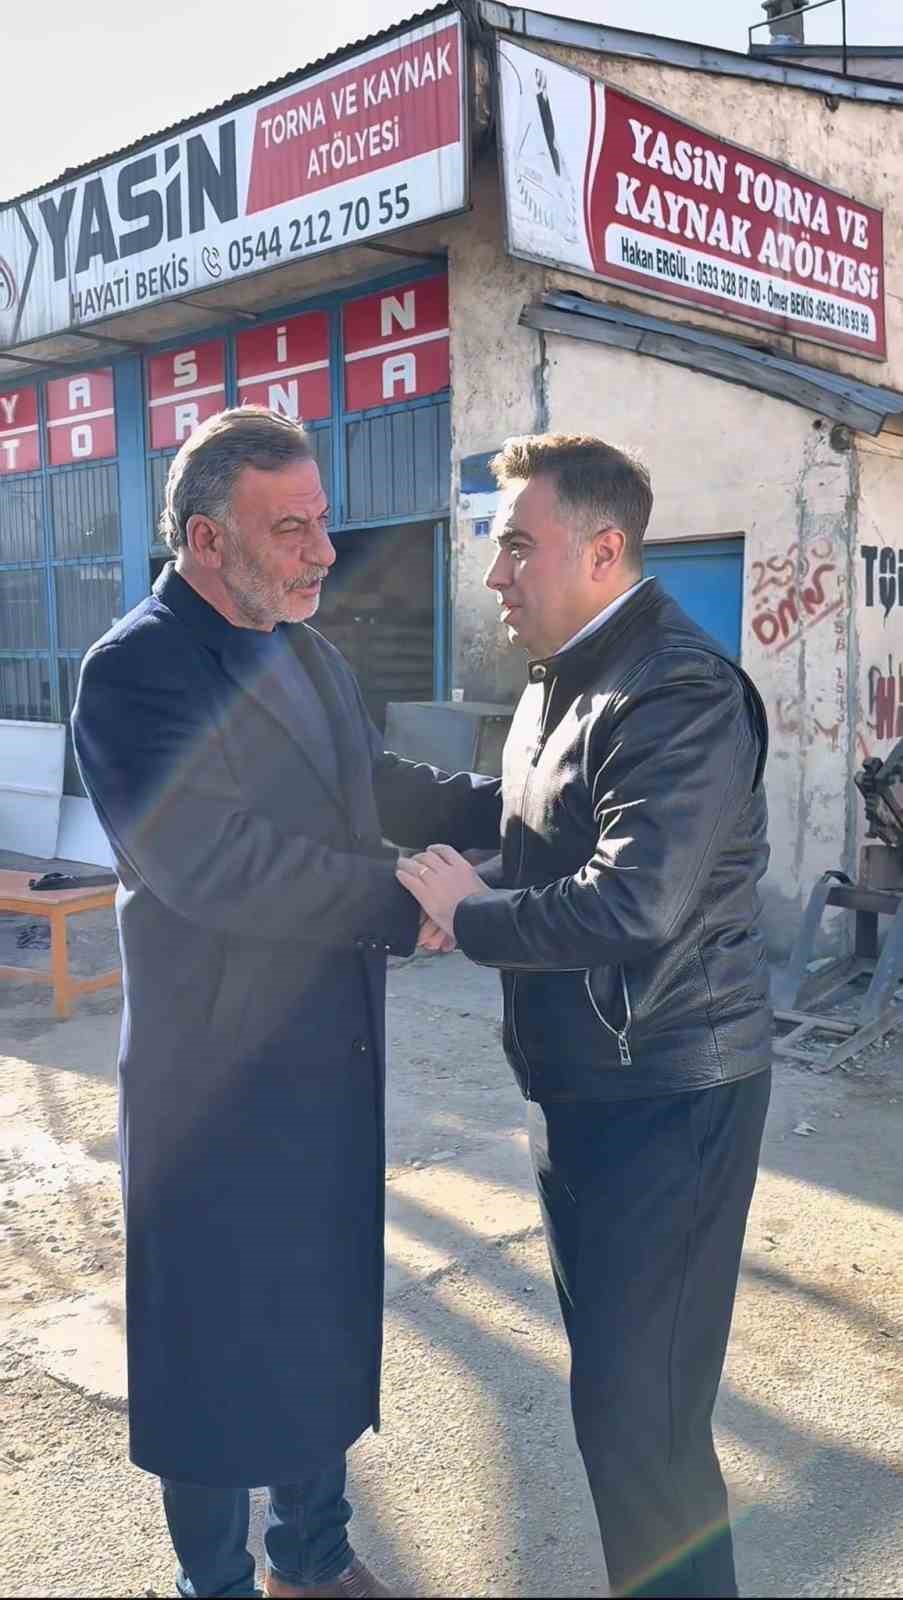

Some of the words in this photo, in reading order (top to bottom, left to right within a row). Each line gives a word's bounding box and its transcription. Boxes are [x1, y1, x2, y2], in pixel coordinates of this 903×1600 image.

[261, 98, 326, 149] TORNA
[331, 83, 358, 120] VE
[363, 43, 452, 108] KAYNAK
[229, 226, 282, 271] 0544
[289, 210, 332, 251] 212
[340, 197, 370, 236] 70
[379, 184, 409, 224] 55
[615, 172, 751, 258] KAYNAK
[735, 162, 831, 235] TORNA
[836, 206, 869, 250] VE
[71, 270, 129, 319] HAYATİ
[136, 253, 188, 299] BEKİS
[621, 236, 654, 270] Hakan
[656, 248, 689, 281] ERGÜL
[697, 261, 718, 290] 0533
[721, 269, 736, 296] 328
[767, 279, 789, 312] Ömer
